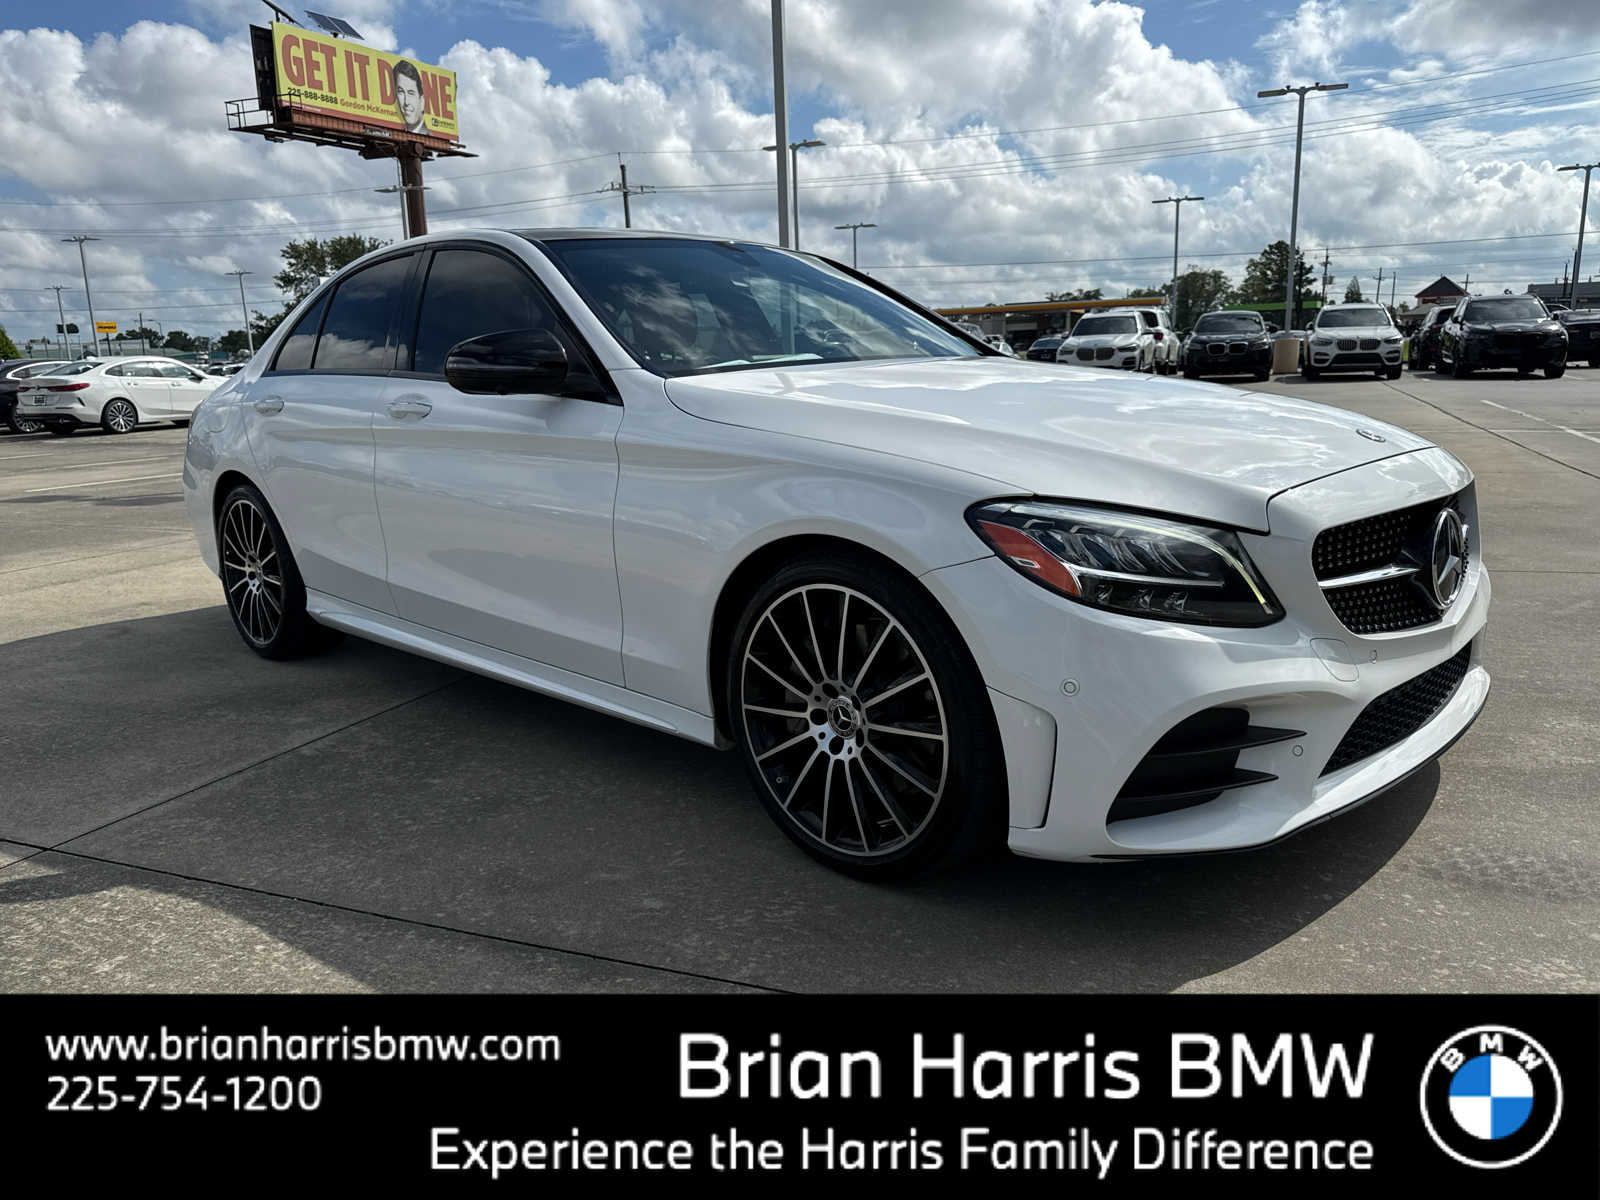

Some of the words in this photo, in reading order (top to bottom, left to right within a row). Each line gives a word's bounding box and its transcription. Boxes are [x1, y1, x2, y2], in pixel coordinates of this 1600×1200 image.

[282, 34, 337, 94] GET
[345, 50, 370, 101] IT
[377, 58, 455, 121] DNE
[287, 87, 338, 105] 225-888-8888
[340, 98, 366, 112] Gordon
